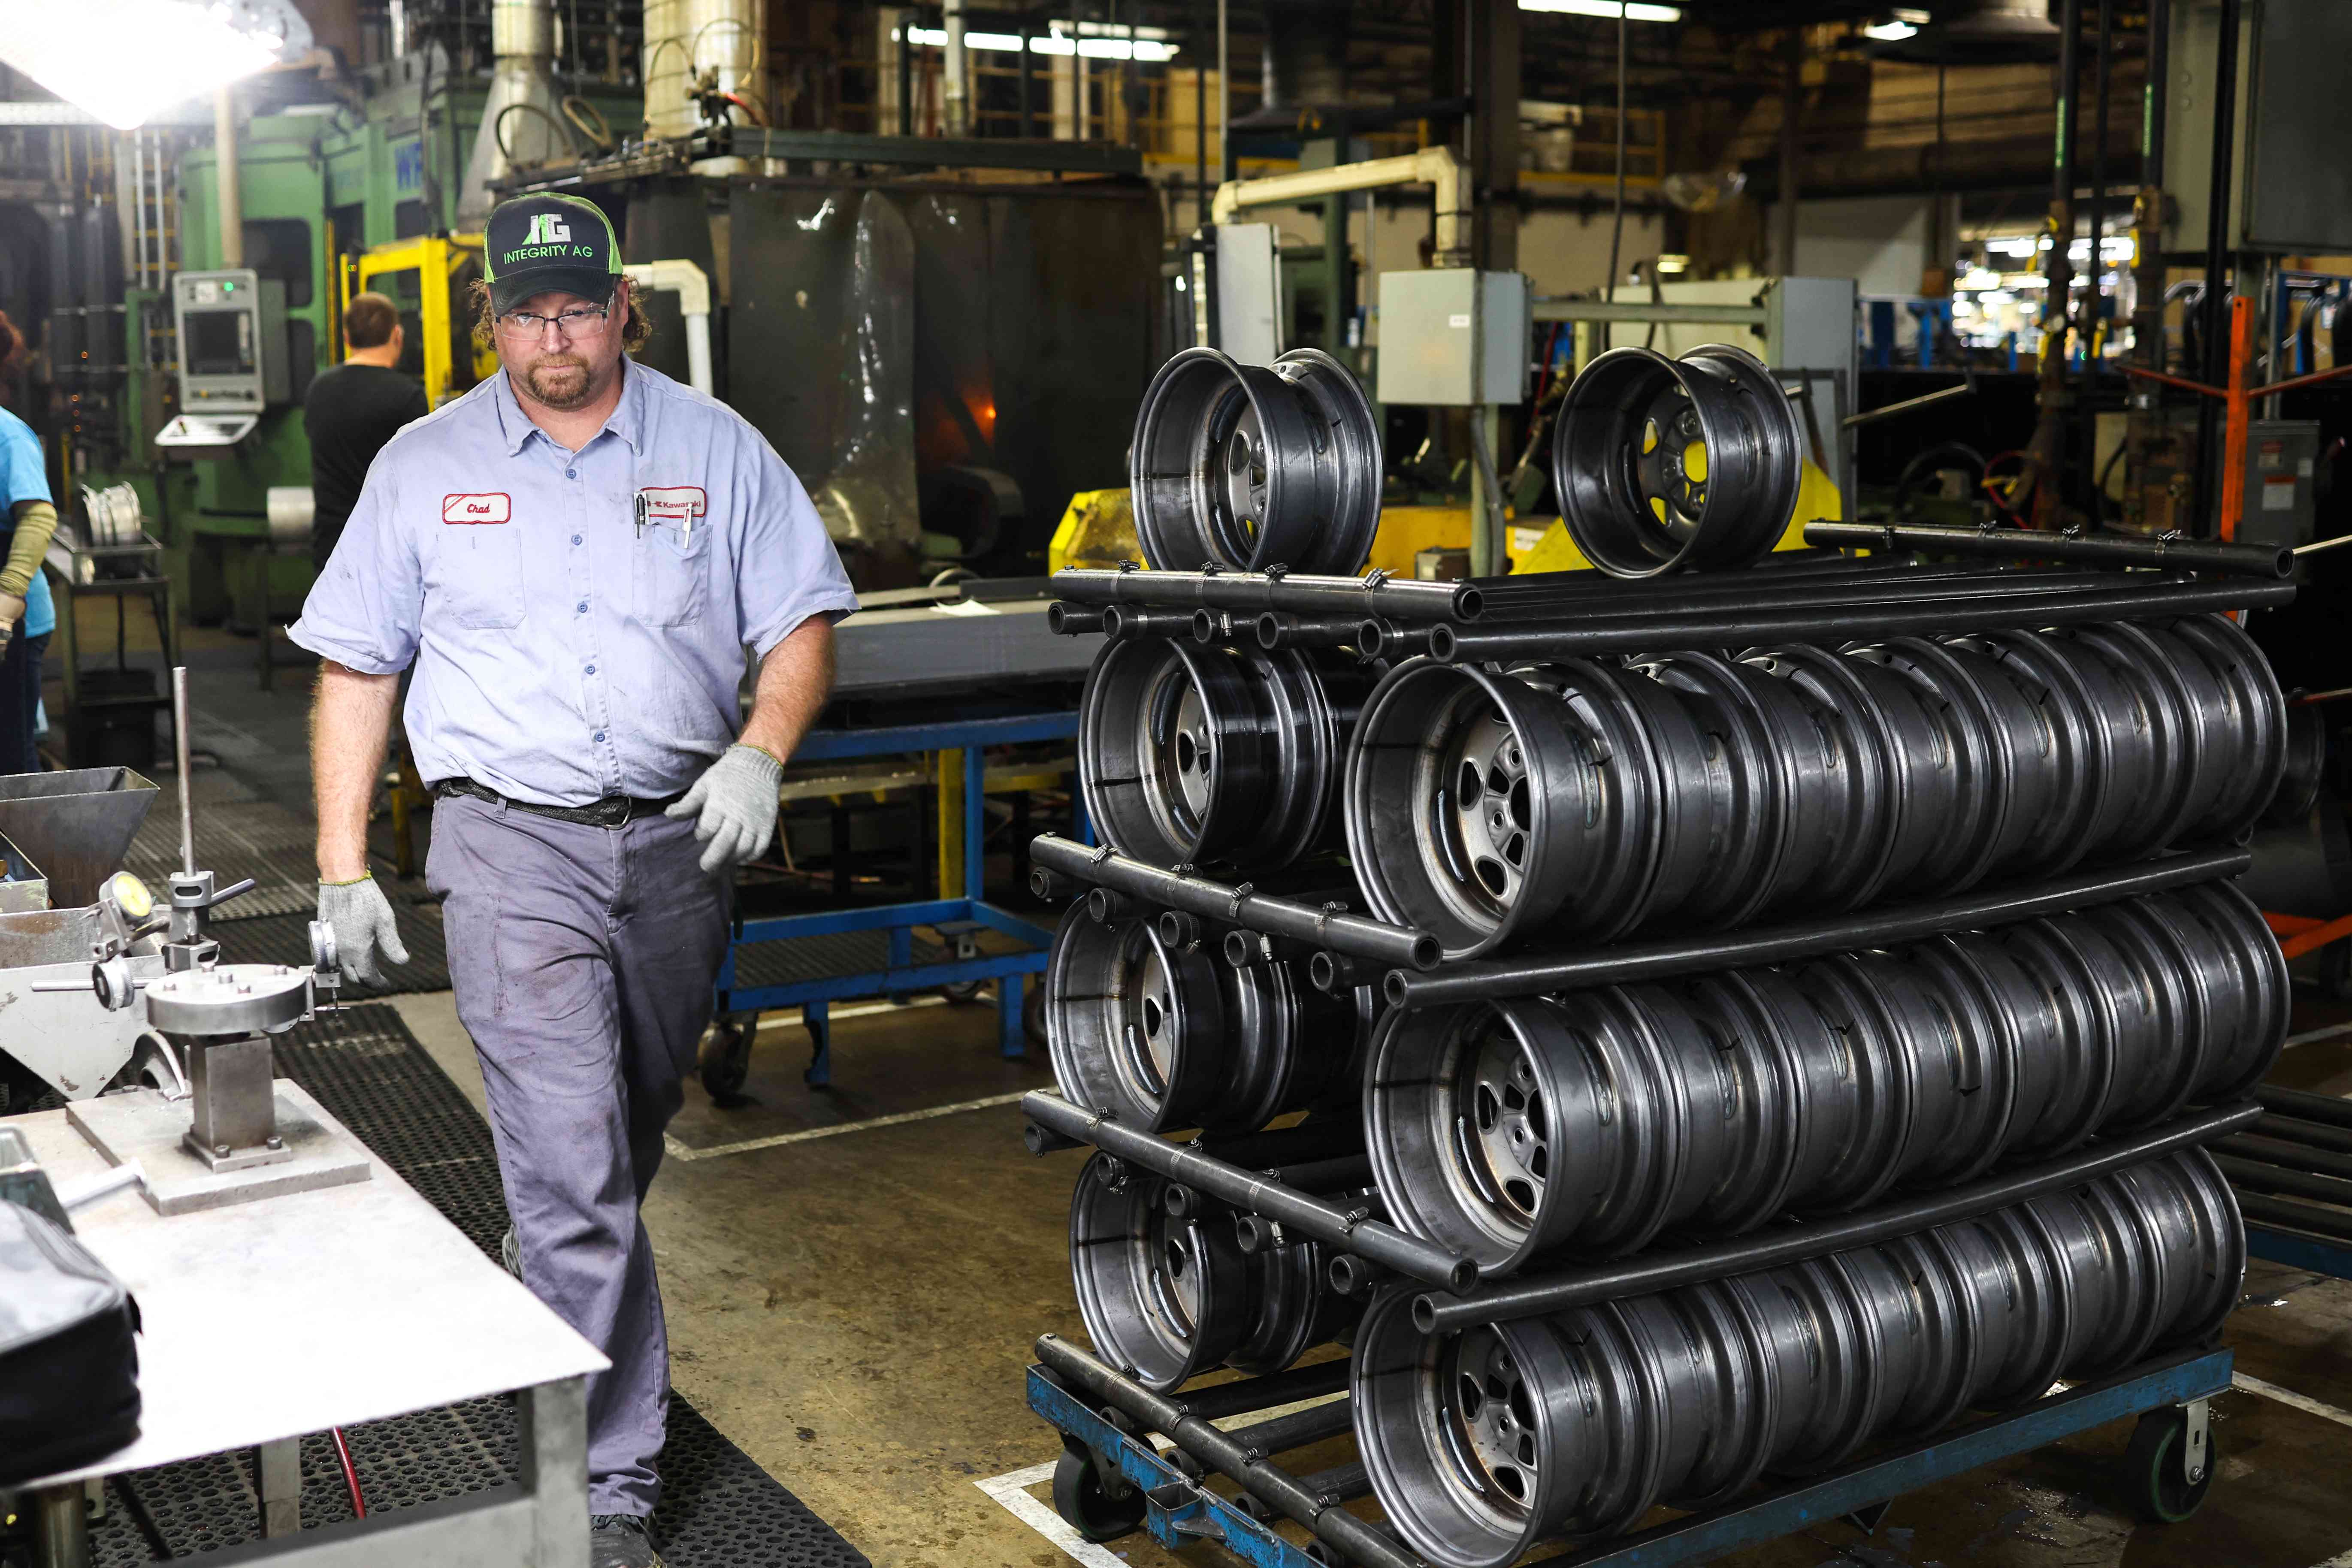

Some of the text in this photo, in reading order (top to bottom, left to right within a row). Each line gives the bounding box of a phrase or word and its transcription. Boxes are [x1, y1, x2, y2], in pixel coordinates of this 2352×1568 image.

[504, 245, 593, 264] INTEGRITY AG
[467, 503, 490, 513] Chad
